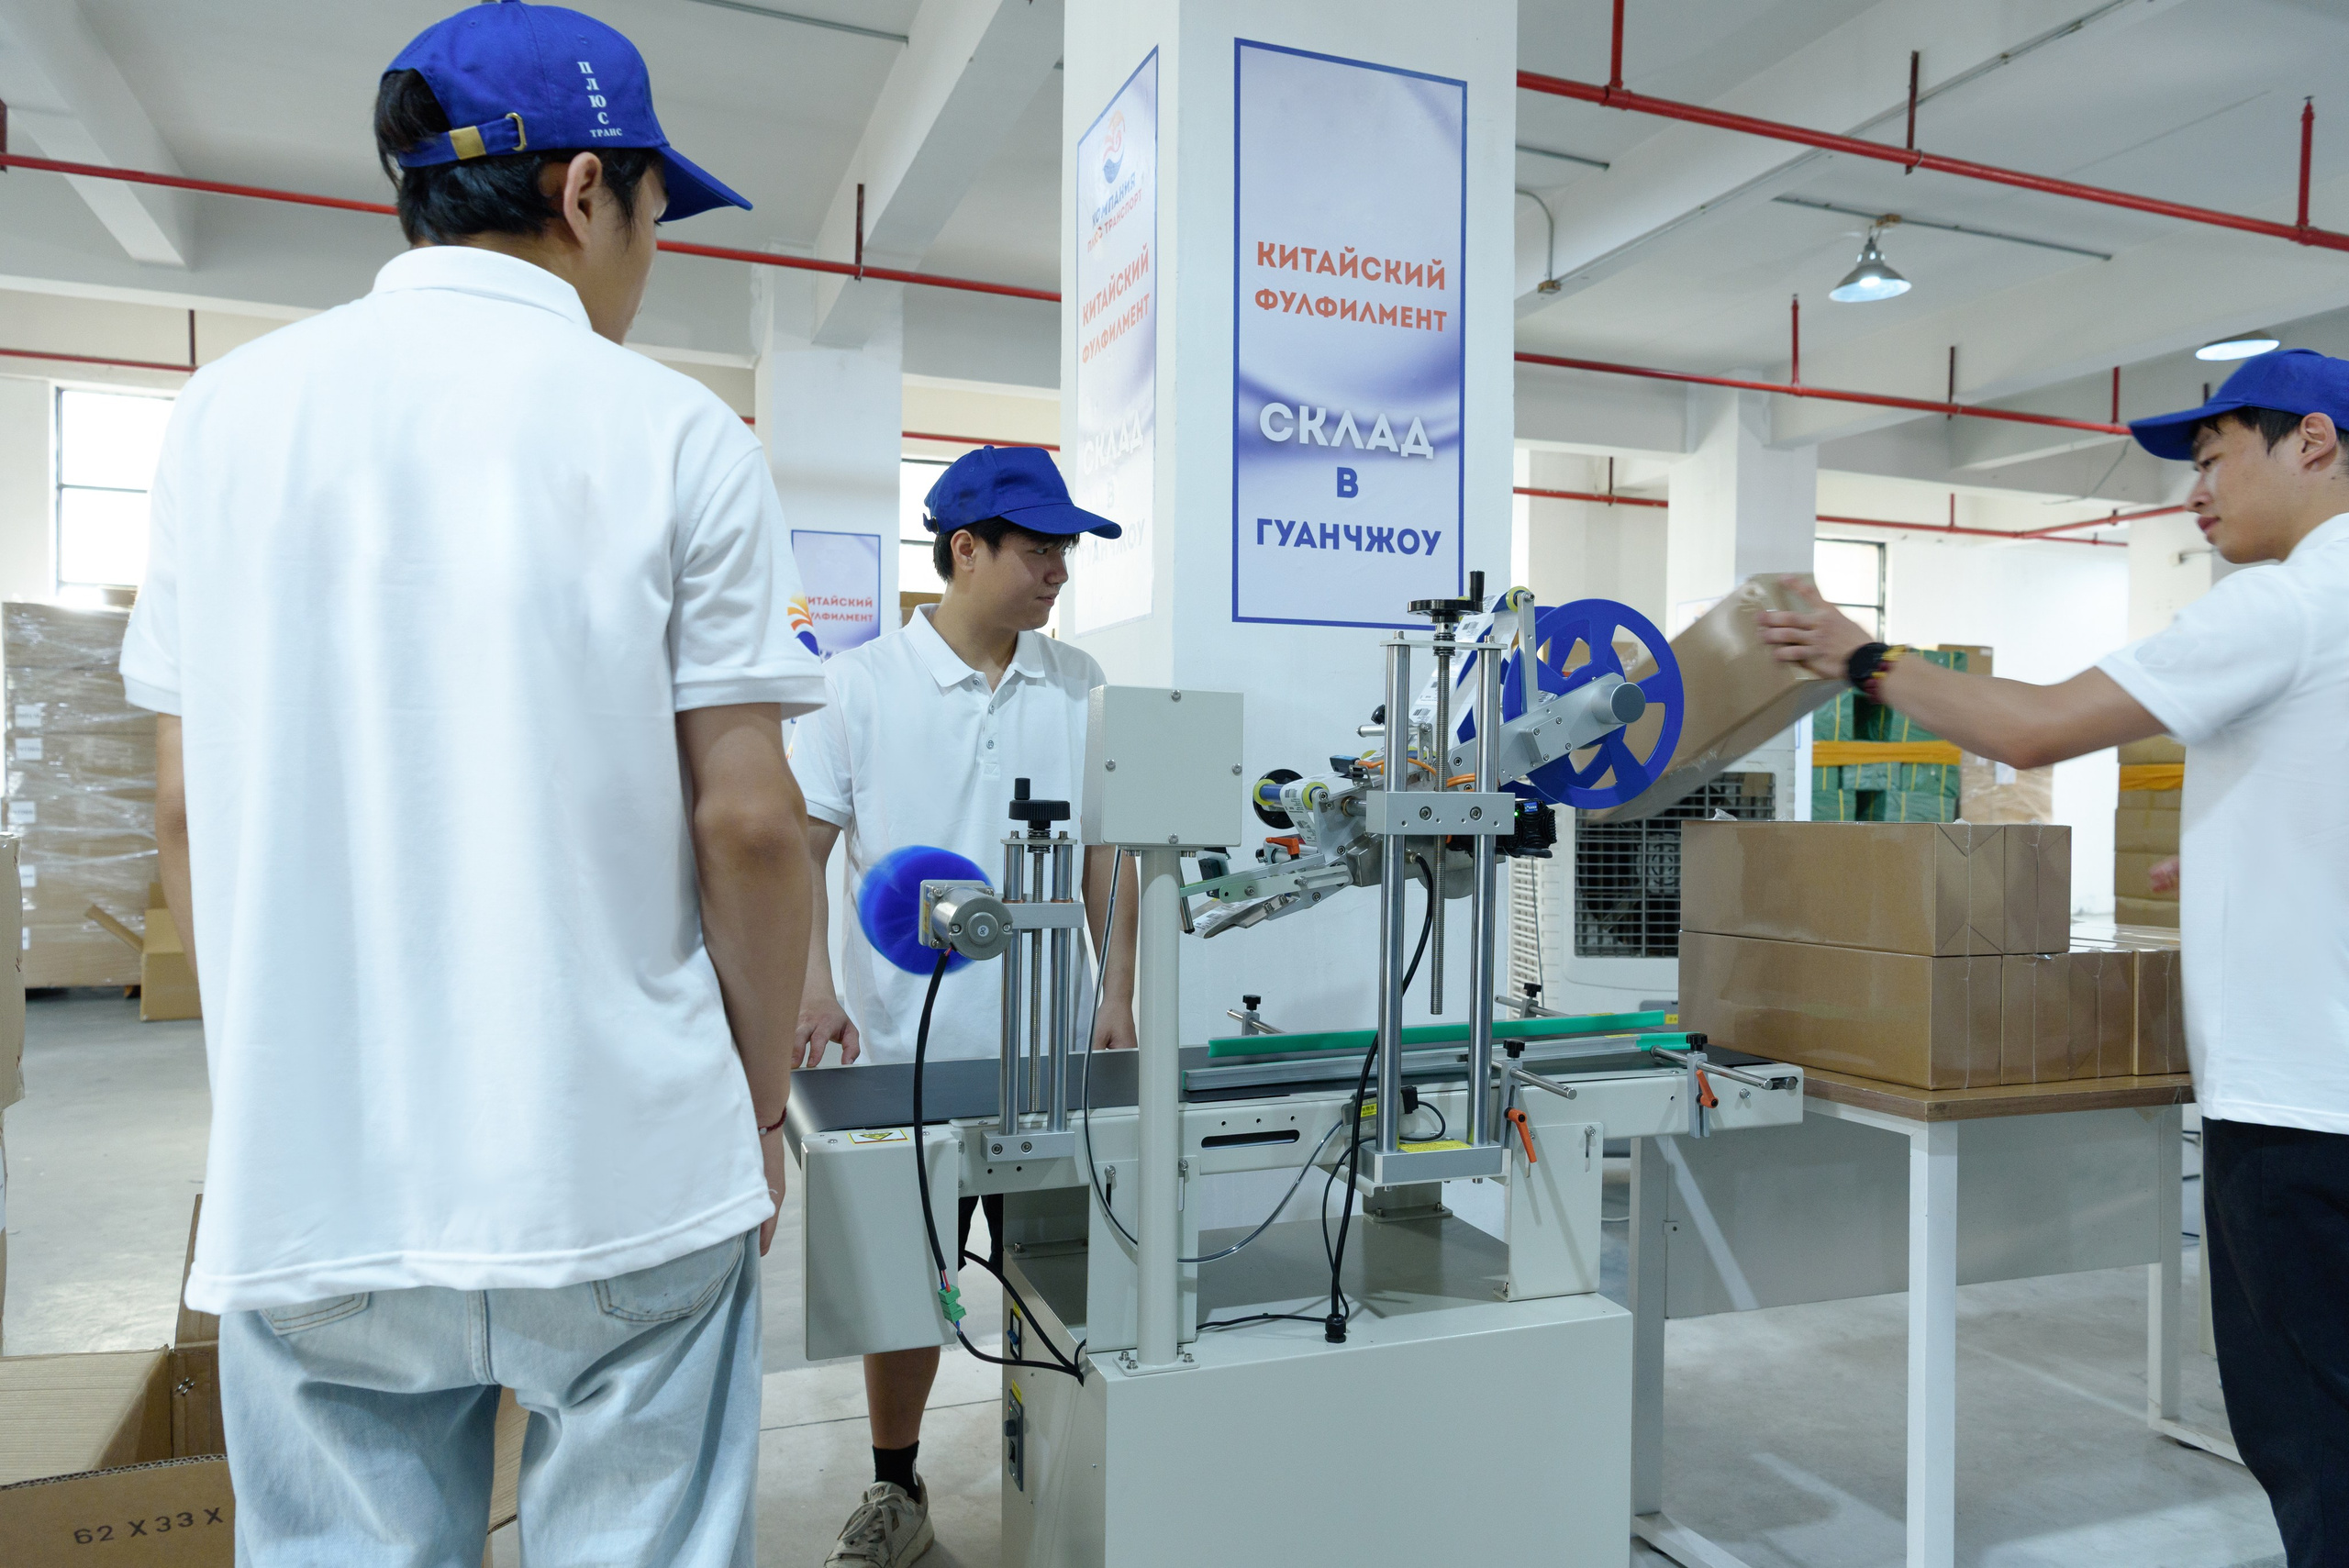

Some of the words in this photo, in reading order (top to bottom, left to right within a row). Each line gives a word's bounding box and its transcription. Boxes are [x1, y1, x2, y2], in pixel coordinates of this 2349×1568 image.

[576, 61, 610, 126] ПЛЮС
[589, 128, 623, 138] ТРАНС
[1092, 171, 1136, 228] КОМПАНИЯ
[1104, 188, 1142, 235] ТРАНСПОРТ
[1083, 242, 1149, 328] КИТАЙСКИЙ
[1257, 240, 1446, 291] КИТАЙСКИЙ
[1082, 293, 1150, 364] ФУЛФИЛМЕНТ
[1254, 288, 1447, 332] ФУЛФИЛМЕНТ
[1083, 409, 1144, 476] СКЛАД
[1259, 402, 1434, 460] СКЛАД
[1336, 466, 1359, 499] В
[1256, 517, 1442, 556] ГУАНЧЖОУ
[806, 594, 874, 608] ИТАЙСКИЙ
[810, 612, 874, 623] УЛФИЛМЕНТ
[73, 1525, 115, 1545] 62
[154, 1512, 195, 1533] 33
